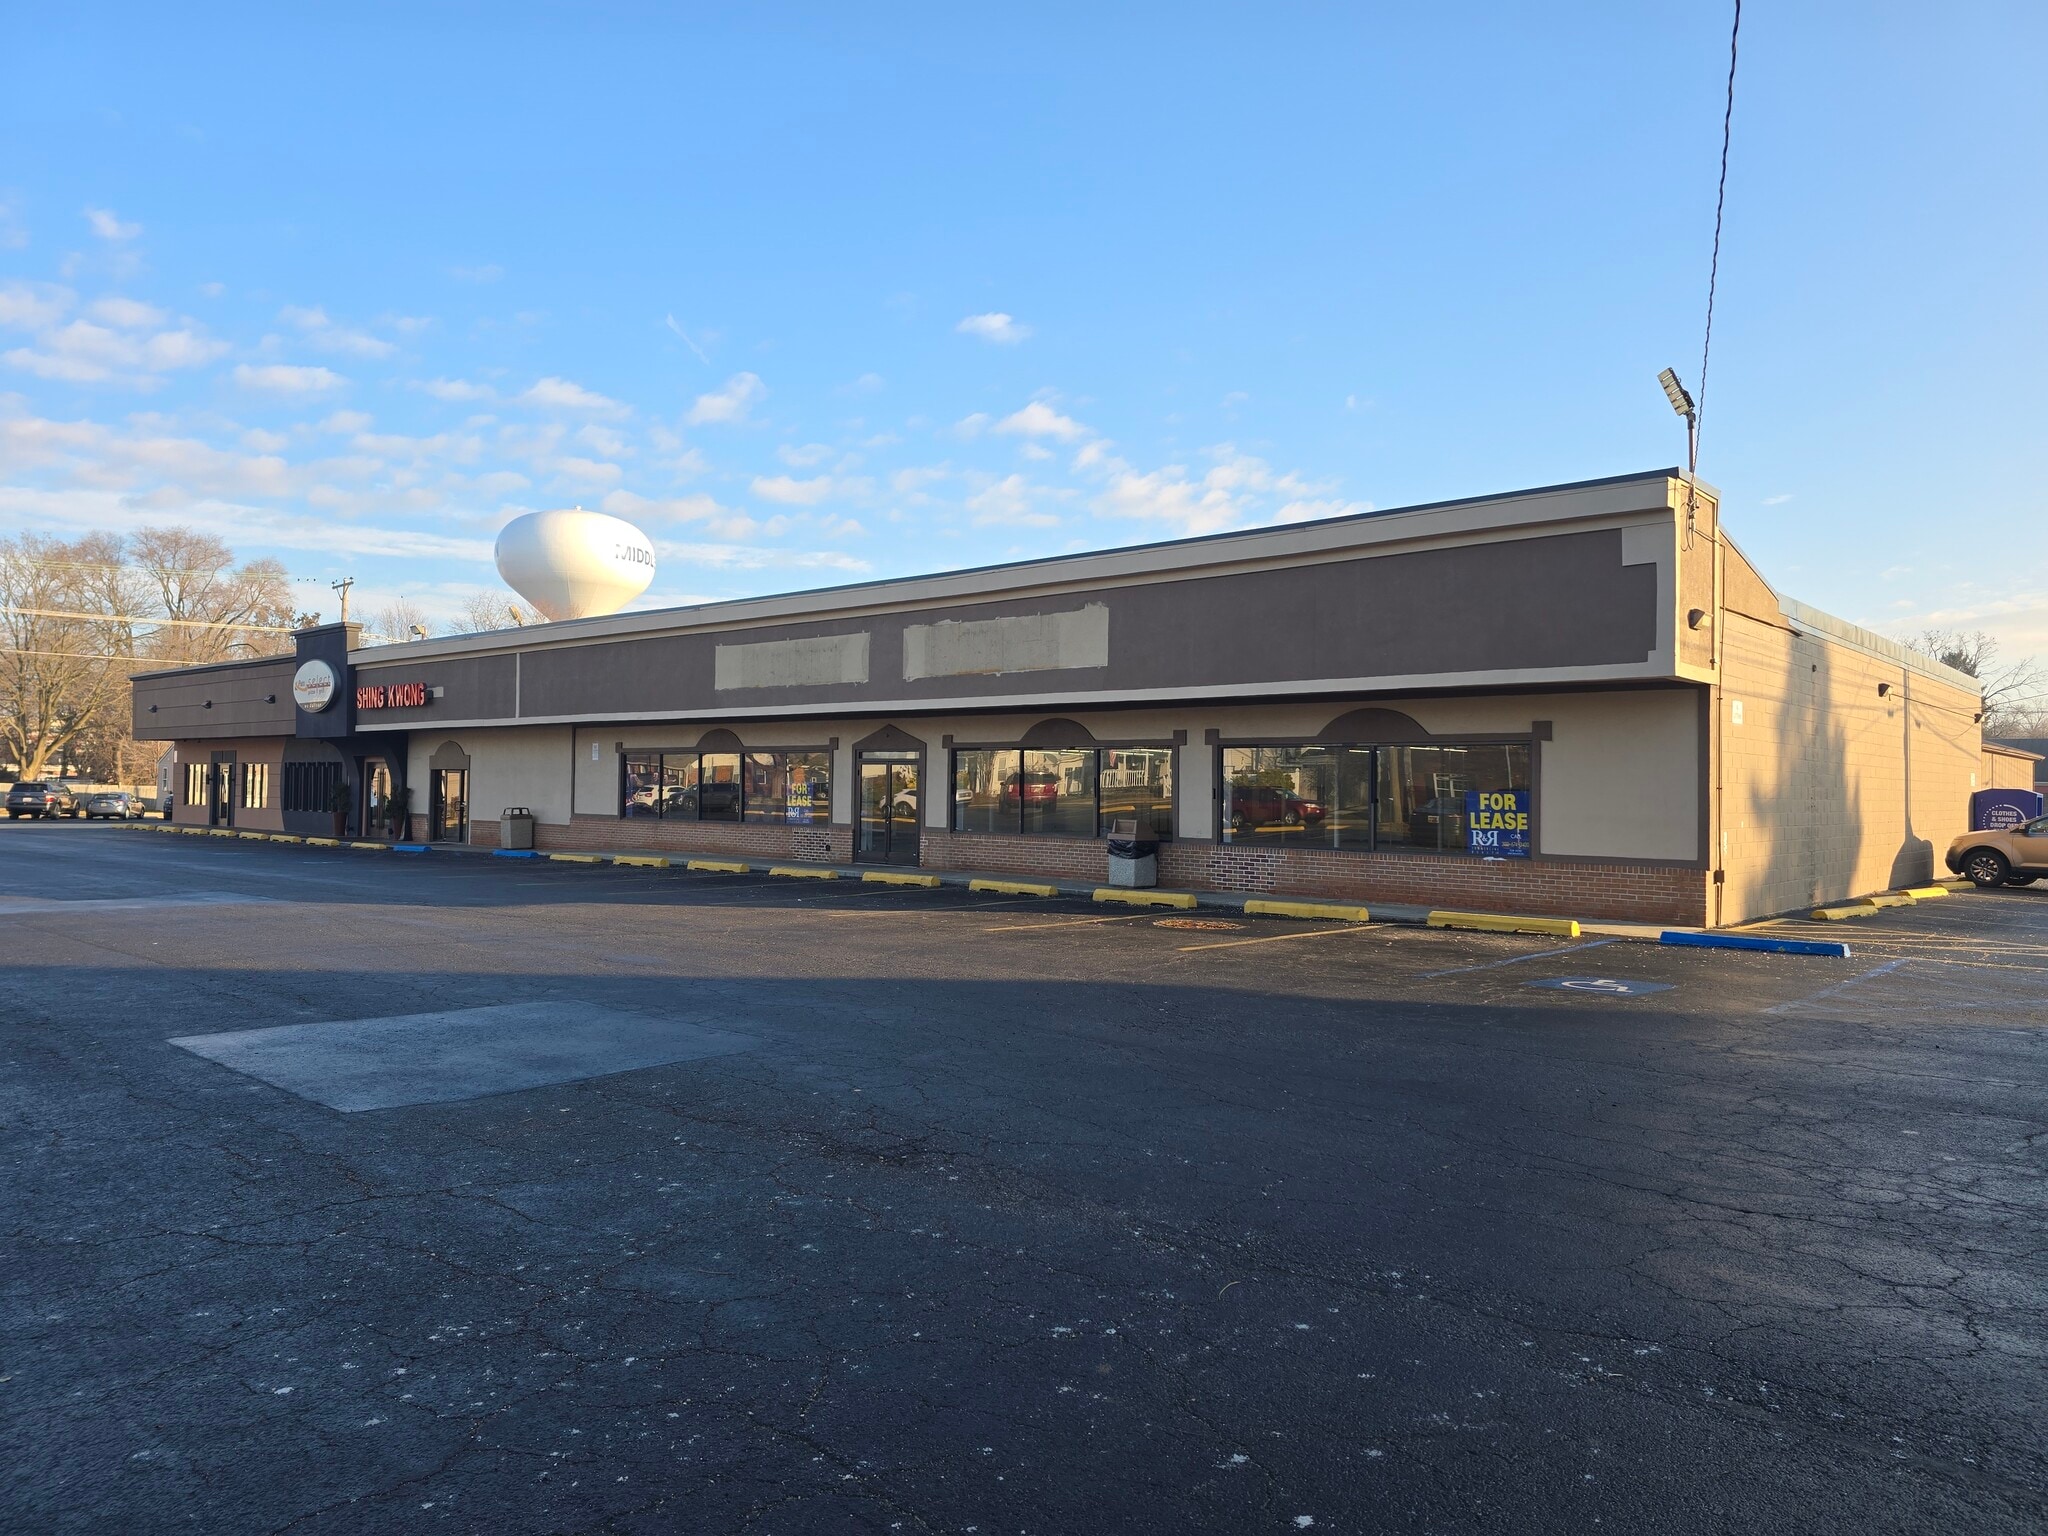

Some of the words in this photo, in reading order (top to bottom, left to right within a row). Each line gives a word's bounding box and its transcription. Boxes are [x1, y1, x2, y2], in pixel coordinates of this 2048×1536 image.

[356, 686, 385, 709] SHING
[387, 683, 426, 708] KWONG
[791, 783, 807, 794] FOR
[787, 795, 812, 806] LEASE
[1480, 793, 1516, 810] FOR
[1470, 812, 1528, 830] LEASE
